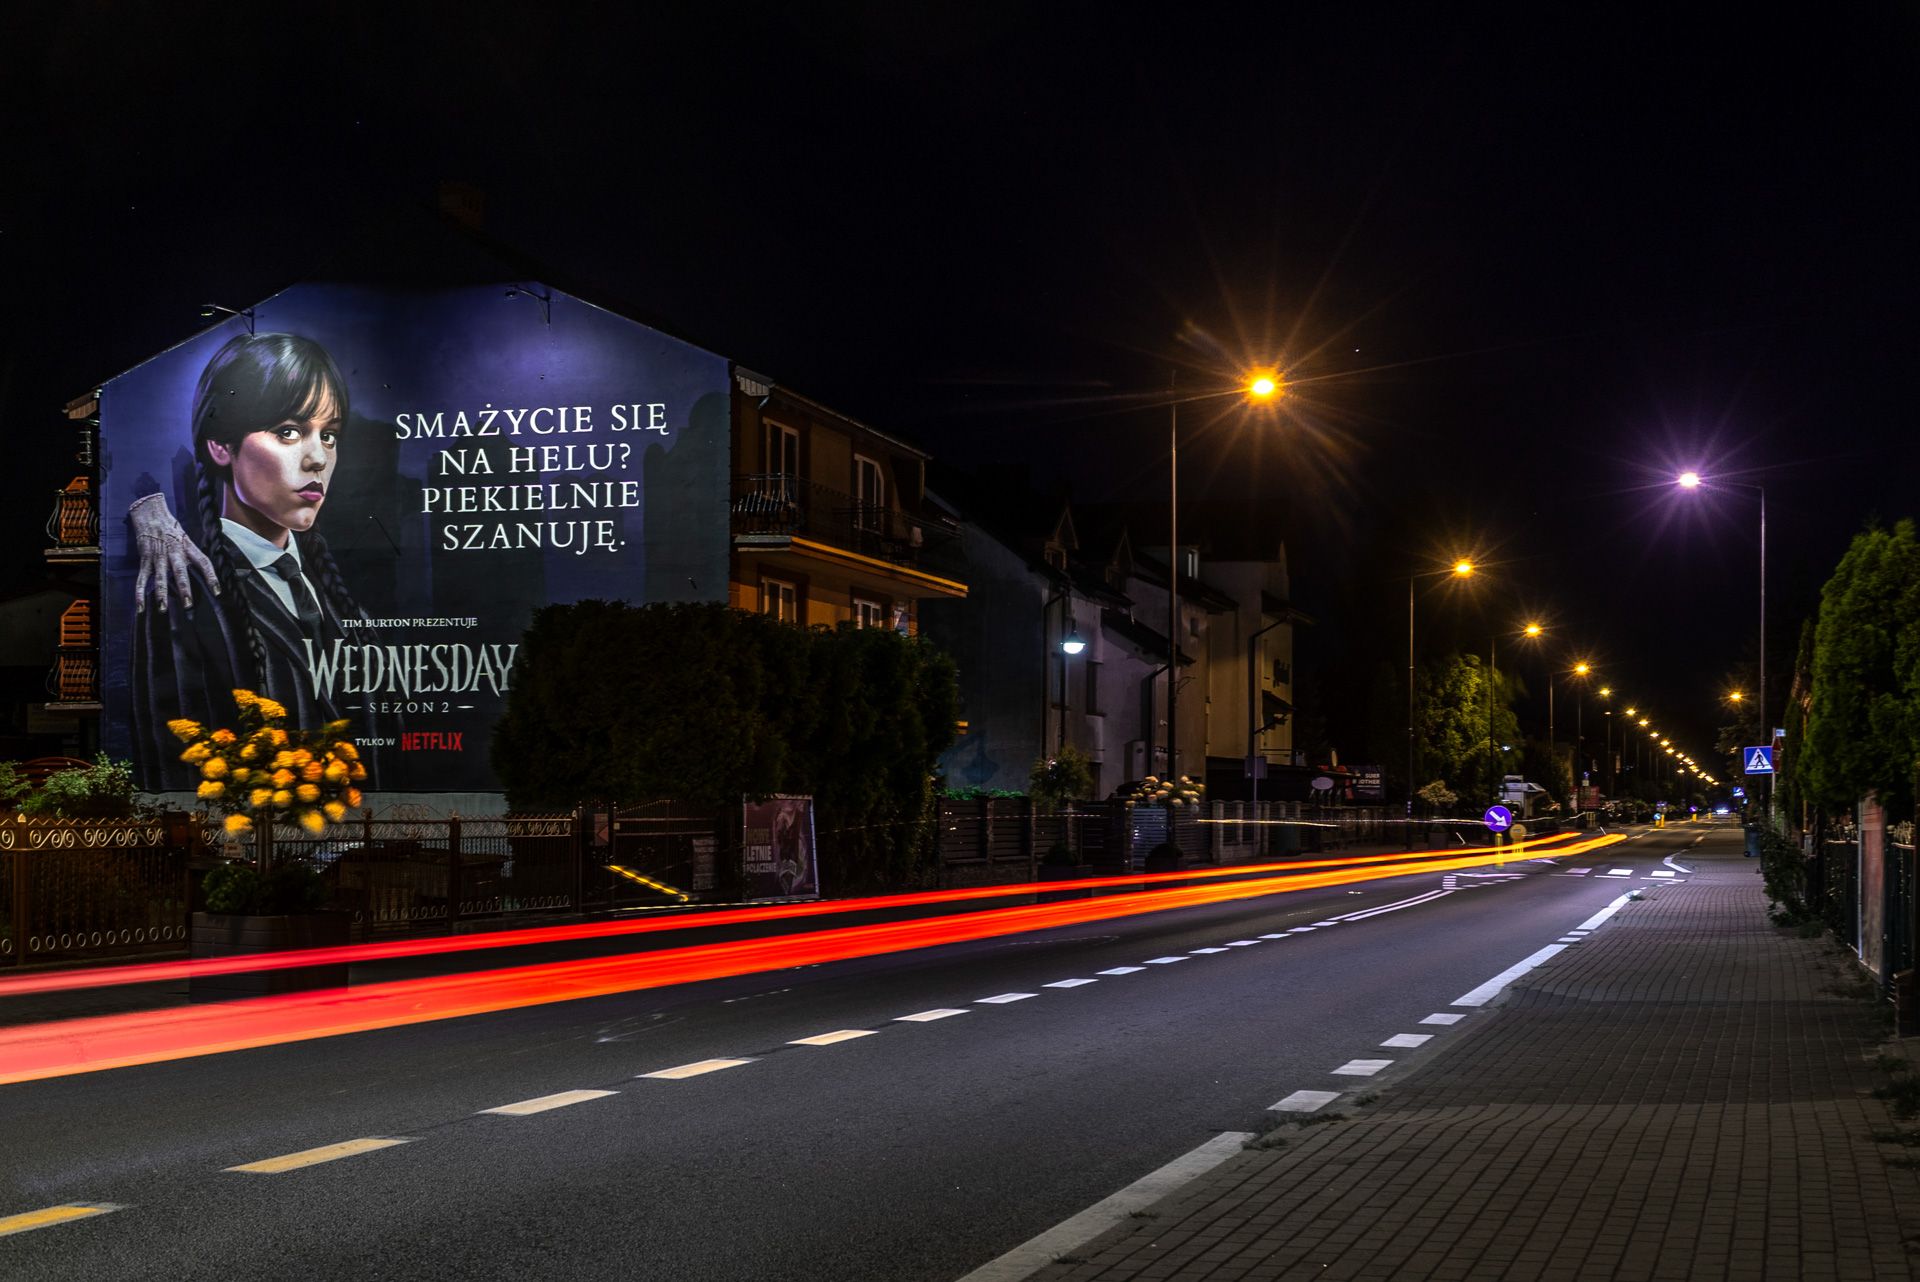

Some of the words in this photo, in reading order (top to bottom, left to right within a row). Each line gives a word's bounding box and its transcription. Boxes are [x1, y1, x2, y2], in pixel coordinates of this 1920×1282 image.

[396, 403, 593, 440] SMAŻYCIE
[611, 403, 669, 436] SIĘ
[440, 448, 494, 475] NA
[508, 443, 631, 473] HELU?
[421, 481, 640, 513] PIEKIELNIE
[443, 520, 626, 556] SZANUJĘ.
[342, 619, 362, 628] TIM
[365, 618, 411, 628] BURTON
[412, 617, 478, 629] PREZENTUJE
[302, 638, 519, 700] WEDNESDAY
[369, 702, 434, 713] SEZON
[441, 702, 450, 713] 2
[355, 737, 383, 746] TYLKO
[383, 737, 396, 746] W
[401, 732, 463, 751] NETFLIX
